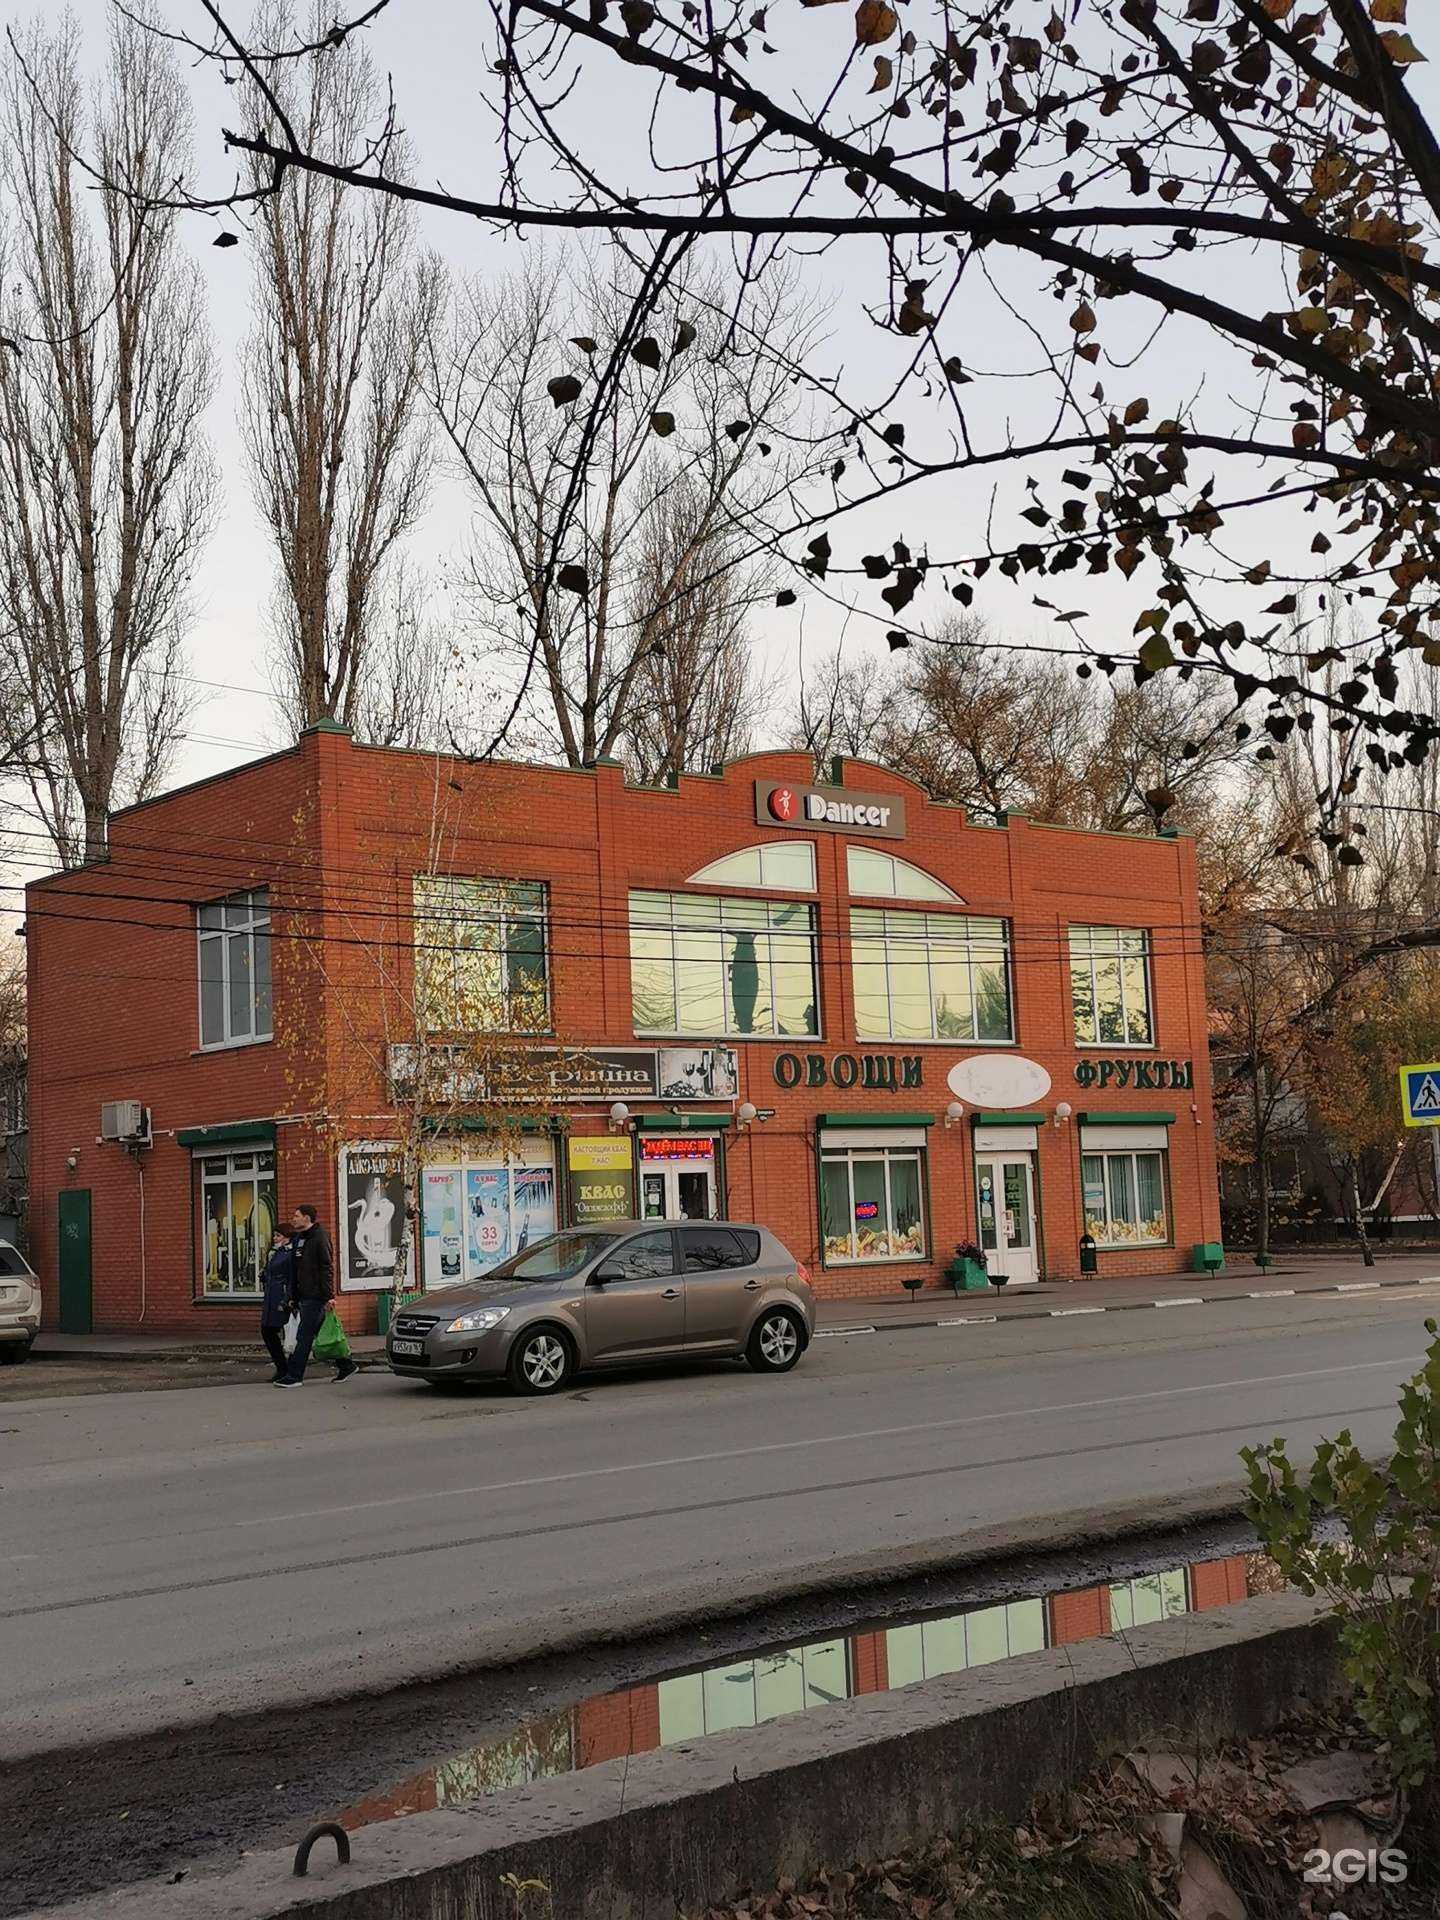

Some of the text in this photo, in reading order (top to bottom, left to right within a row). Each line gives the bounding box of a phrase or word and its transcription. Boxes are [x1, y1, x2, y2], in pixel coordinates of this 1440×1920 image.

[806, 794, 890, 827] Dancer
[773, 1053, 923, 1093] ОВОЩИ
[1074, 1059, 1193, 1088] ФРУКТЫ
[580, 1185, 626, 1200] КВАС
[482, 1227, 497, 1239] 33
